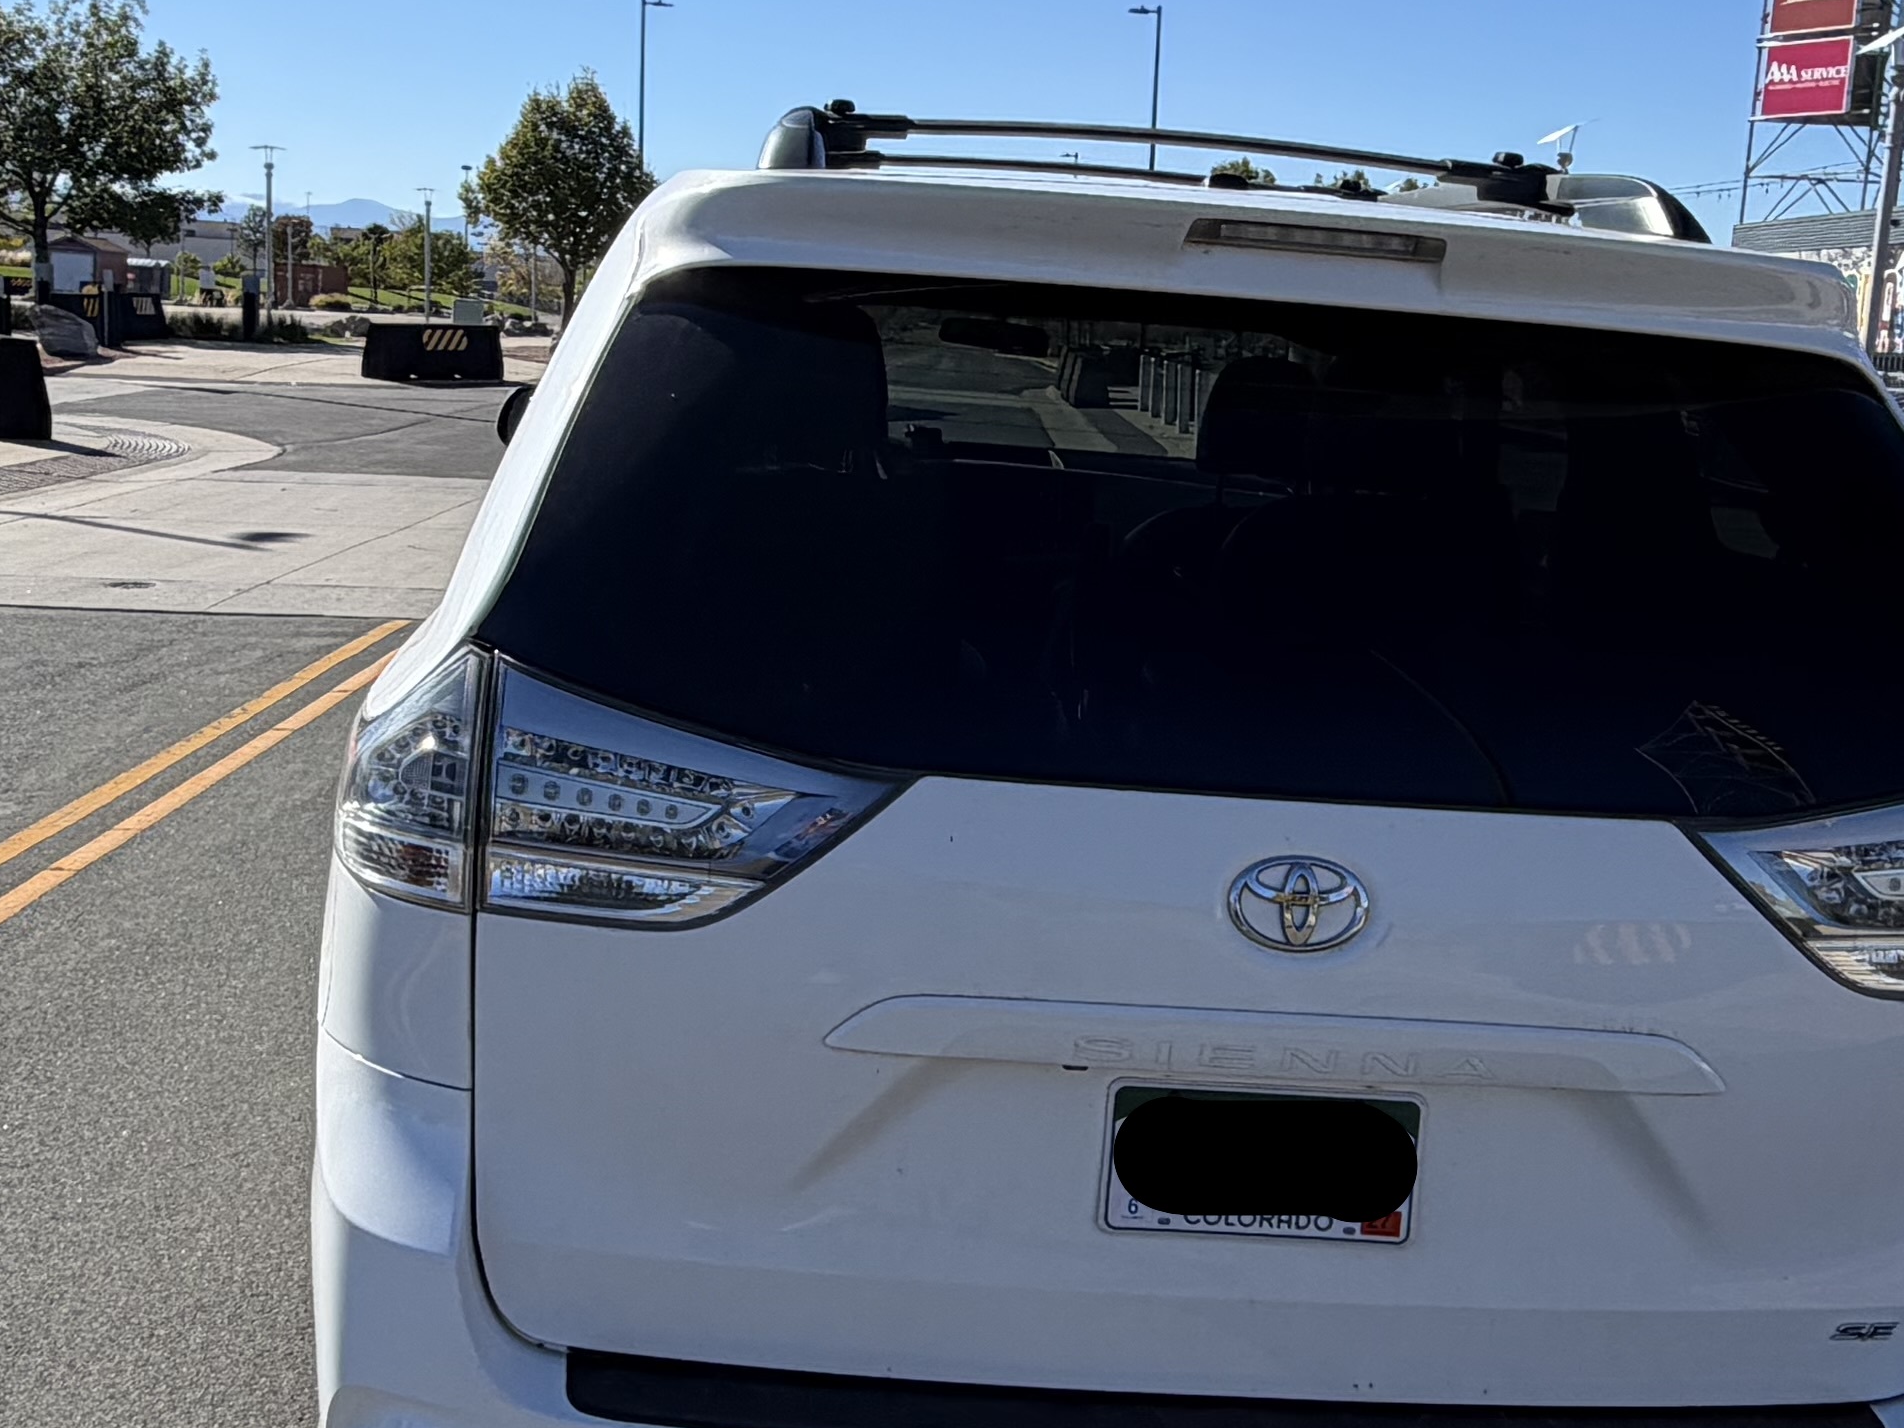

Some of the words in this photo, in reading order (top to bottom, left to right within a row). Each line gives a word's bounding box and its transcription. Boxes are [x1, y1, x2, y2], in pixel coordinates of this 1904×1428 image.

[1800, 65, 1848, 82] SERVICE
[1073, 1037, 1496, 1081] SIENNA
[1128, 1198, 1138, 1215] 6
[1829, 1321, 1900, 1342] SE
